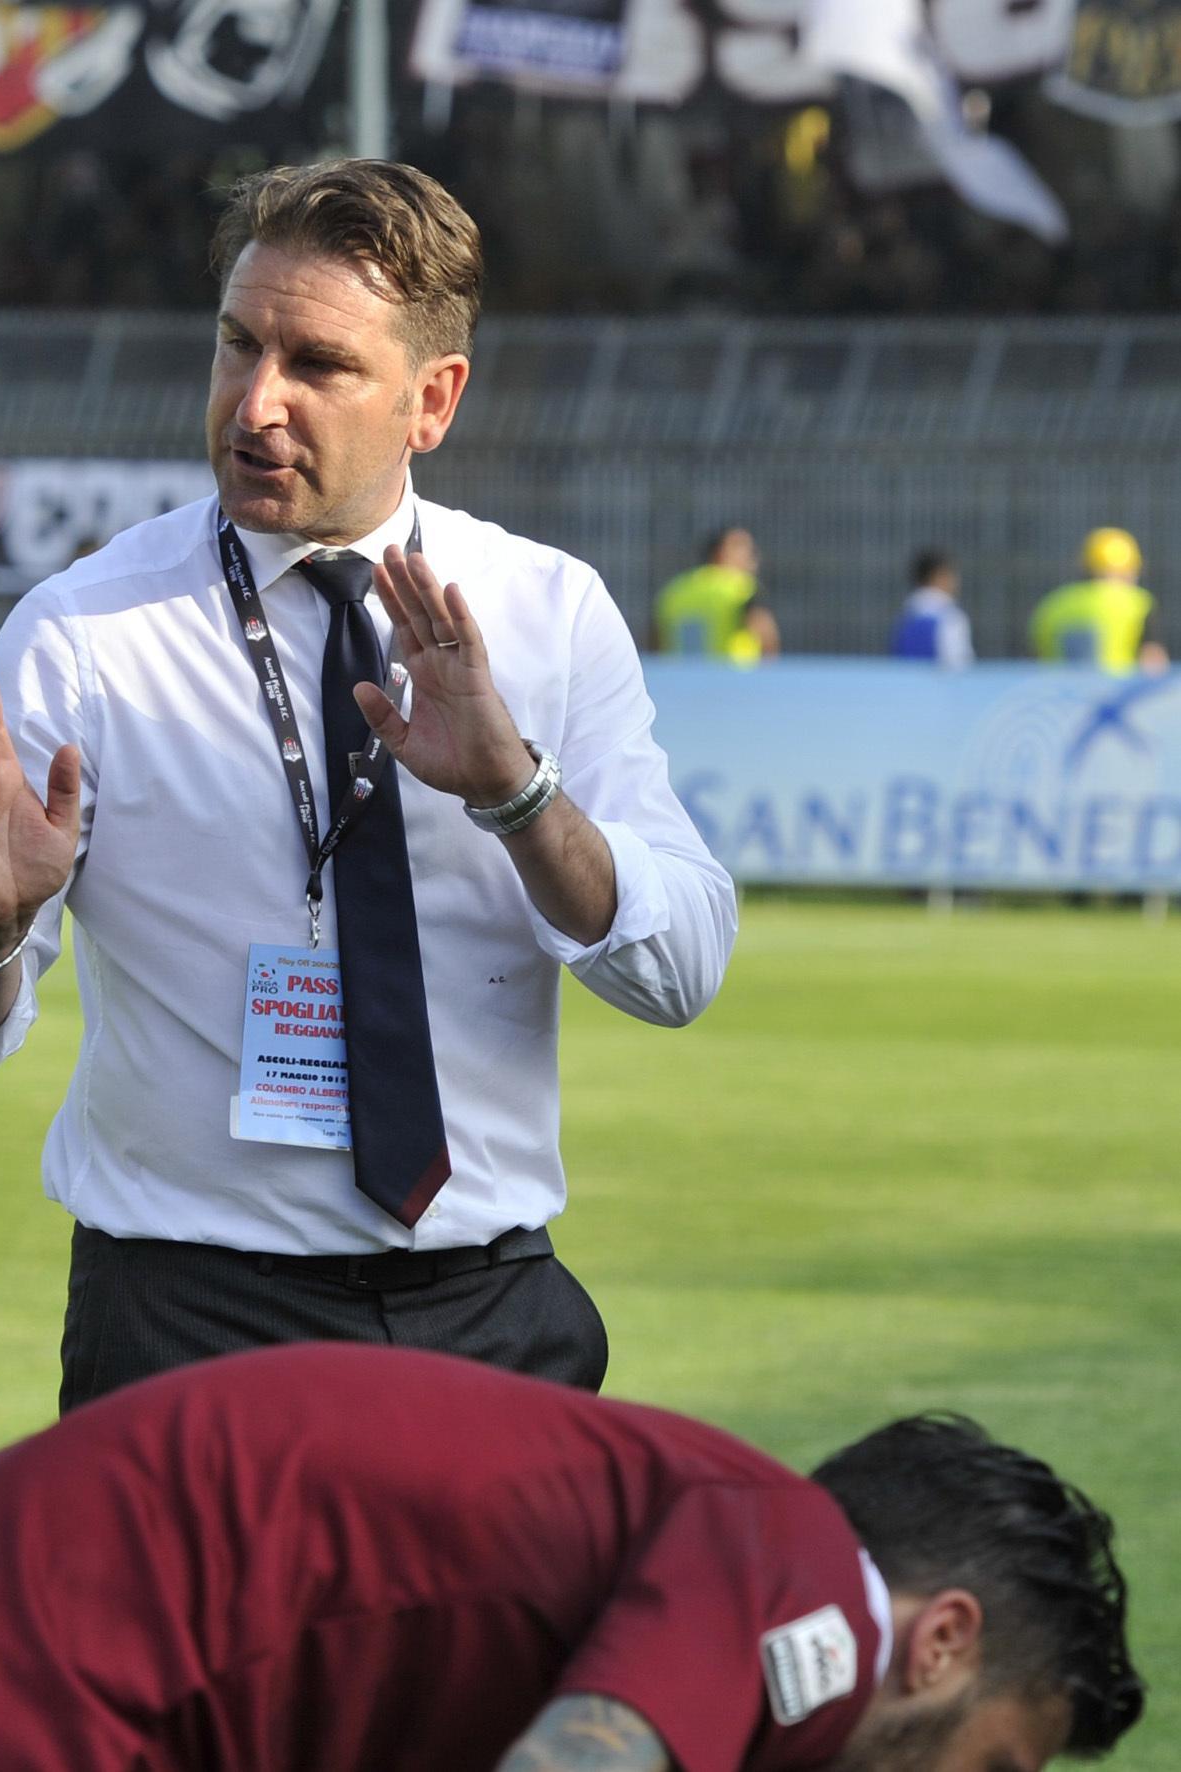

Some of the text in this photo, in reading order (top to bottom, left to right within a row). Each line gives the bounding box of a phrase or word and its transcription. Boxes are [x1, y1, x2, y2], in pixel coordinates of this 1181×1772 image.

[264, 656, 278, 679] Ascoli
[252, 985, 279, 995] PRO
[287, 975, 339, 996] PASS
[280, 1071, 318, 1082] MAGGIO
[255, 1082, 307, 1096] COLOMBO
